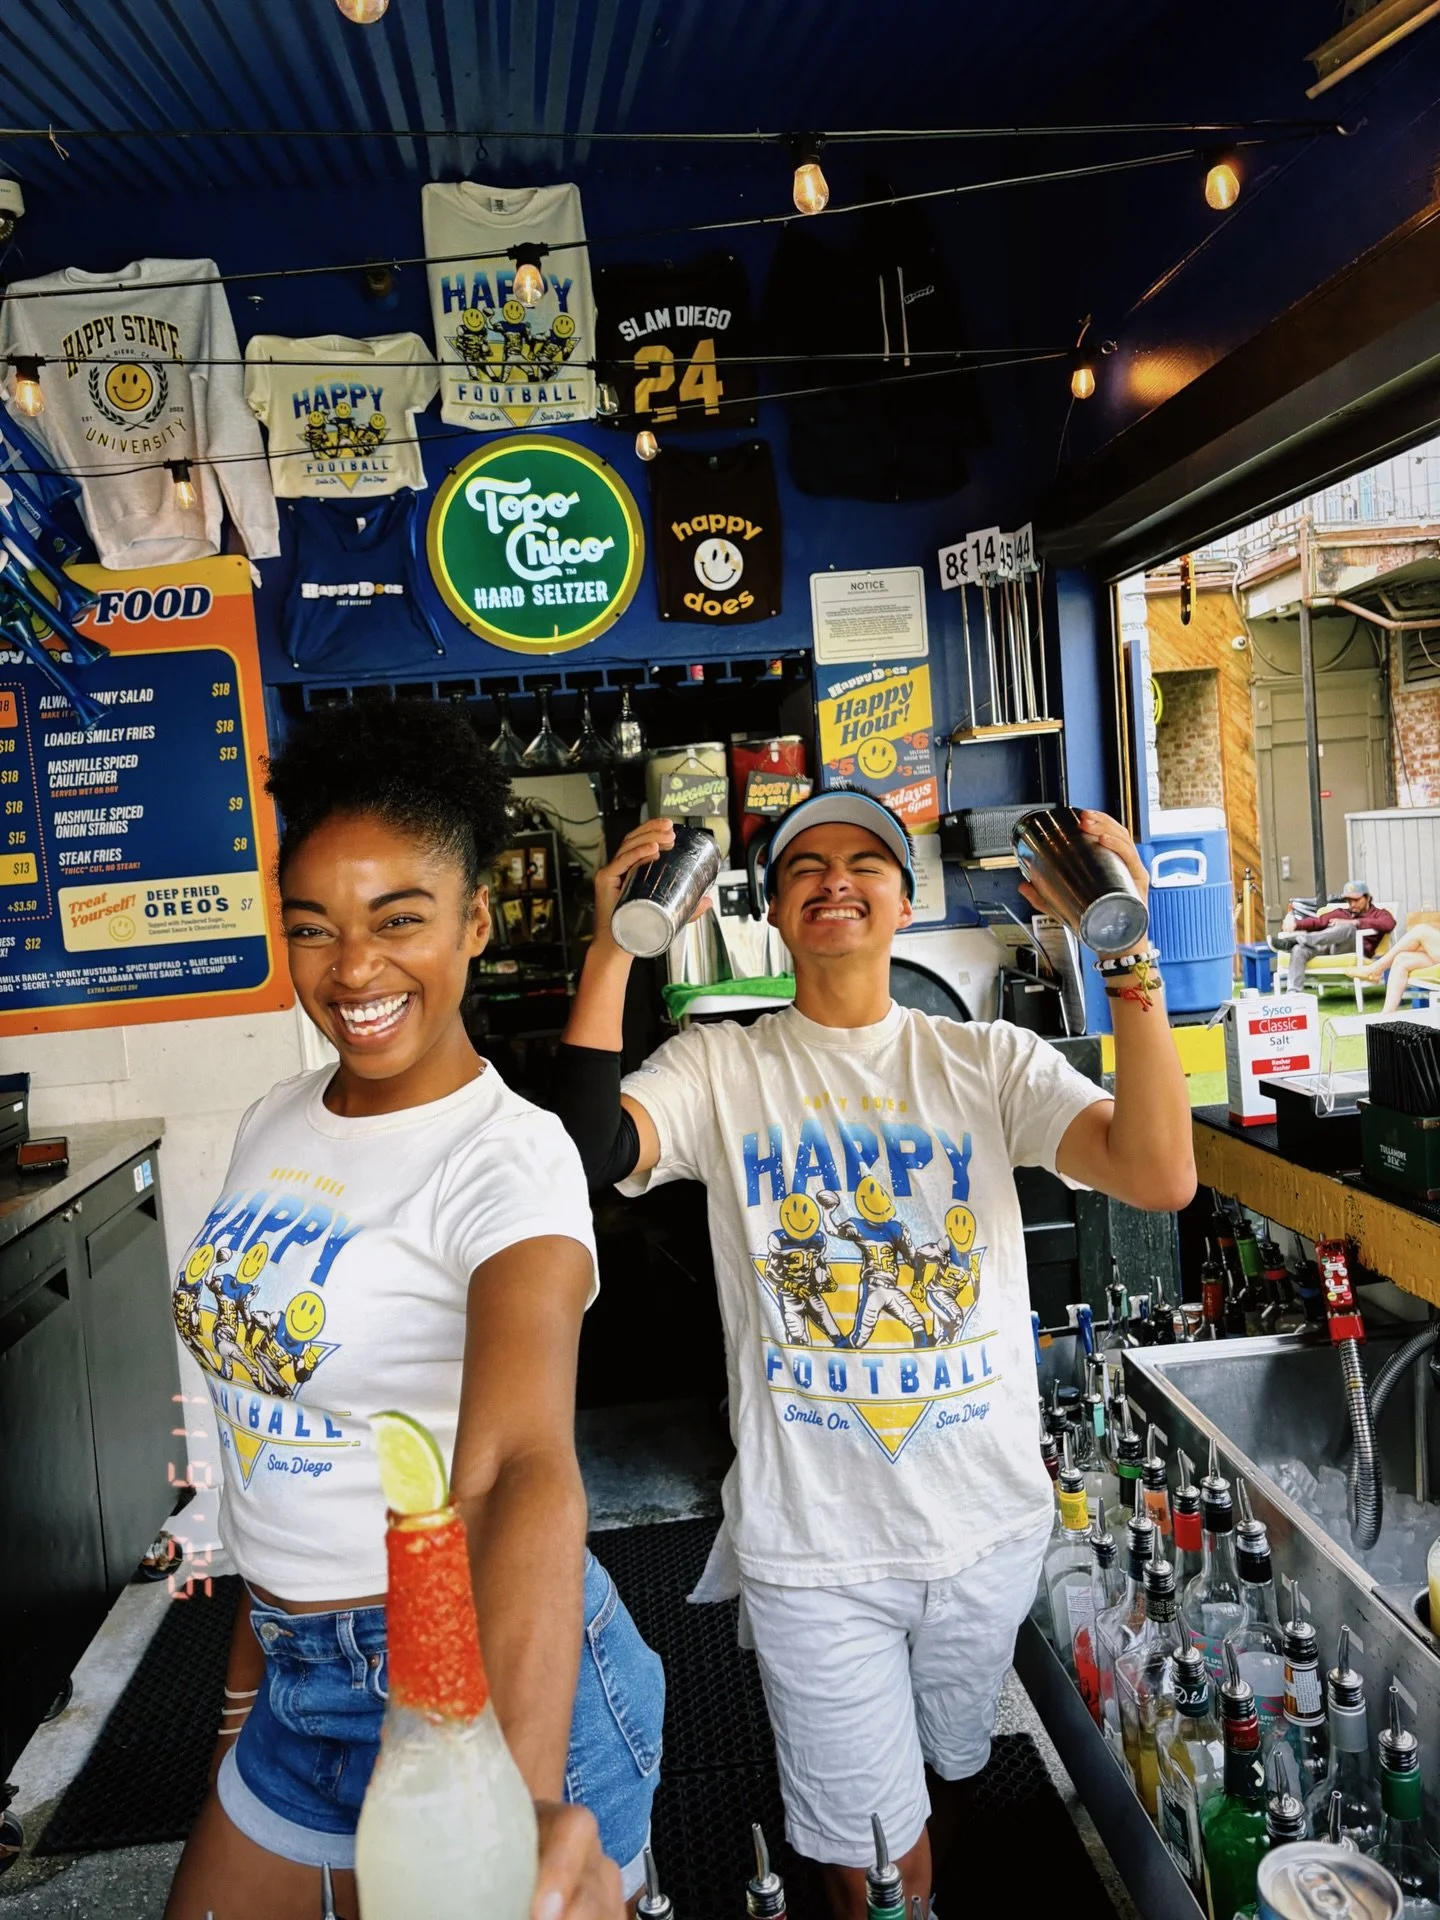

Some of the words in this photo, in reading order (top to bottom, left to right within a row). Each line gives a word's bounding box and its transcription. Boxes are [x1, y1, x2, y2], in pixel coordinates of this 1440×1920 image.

[441, 268, 573, 314] HAPY
[618, 308, 671, 342] SLAM
[675, 305, 732, 331] DIEGO
[62, 316, 116, 379] HAPPY
[121, 315, 184, 367] STATE
[458, 383, 577, 403] FOOTBALL
[634, 338, 724, 423] 24
[292, 382, 384, 420] HAPPY
[490, 412, 501, 422] On
[86, 418, 187, 455] UNIVERSITY
[306, 460, 389, 474] FOOTBALL
[465, 476, 580, 534] Topo
[671, 513, 763, 541] happy
[505, 521, 615, 582] Chico
[972, 536, 996, 567] 14
[474, 586, 525, 610] HARD
[532, 580, 609, 606] SELTZER
[850, 581, 885, 590] NOTICE
[96, 586, 212, 624] FOOD
[683, 590, 755, 616] does
[0, 700, 9, 712] 18
[120, 688, 154, 703] SALAD
[212, 683, 230, 697] $18
[833, 680, 914, 725] Happy
[44, 732, 84, 748] LOADED
[86, 728, 125, 744] SMILEY
[126, 725, 156, 741] FRIES
[216, 719, 234, 734] $18
[840, 704, 910, 746] Hour!
[48, 757, 102, 775] NASHVILLE
[103, 754, 138, 770] SPICED
[220, 746, 238, 761] $13
[1, 770, 19, 785] $18
[49, 769, 118, 789] CAULIFLOWER
[51, 789, 77, 798] SERVED
[663, 780, 726, 806] MARGARITA
[5, 800, 23, 815] $18
[54, 808, 107, 826] NASHVILLE
[109, 805, 144, 821] SPICED
[229, 797, 243, 811] $9
[8, 831, 26, 845] $15
[55, 824, 86, 839] ONION
[88, 820, 128, 836] STRINGS
[233, 837, 248, 851] $8
[13, 862, 30, 876] $13
[58, 849, 92, 867] STEAK
[93, 847, 122, 864] FRIES
[68, 892, 107, 915] Treat
[147, 888, 179, 901] DEEP
[183, 885, 220, 899] FRIED
[7, 900, 37, 913] +$3.50
[71, 894, 137, 929] Yourself!
[144, 897, 229, 919] OREOS
[240, 898, 253, 911] $7
[25, 937, 42, 950] $12
[22, 972, 47, 982] RANCH
[56, 968, 81, 979] HONEY
[82, 965, 117, 977] MUSTARD
[125, 963, 147, 973] SPICY
[149, 960, 181, 971] BUFFALO
[189, 957, 208, 967] BLUE
[209, 955, 237, 965] CHEESE
[22, 980, 50, 991] SECRET
[66, 976, 90, 987] SAUCE
[98, 972, 134, 984] ALABAMA
[135, 969, 158, 980] WHITE
[160, 967, 183, 979] SAUCE
[192, 965, 225, 975] KETCHUP
[1262, 1005, 1292, 1017] Sysco
[1258, 1019, 1298, 1033] Classic
[1270, 1036, 1290, 1046] Salt
[742, 1119, 973, 1207] HAPPY
[1379, 1144, 1407, 1161] TULLAMORE
[197, 1188, 366, 1288] HAPPY
[868, 1245, 894, 1273] 12
[767, 1345, 992, 1394] FOOTBALL
[209, 1379, 342, 1439] OOTBALL
[784, 1404, 823, 1426] Smile
[827, 1412, 850, 1430] On
[936, 1411, 960, 1429] San
[267, 1453, 289, 1471] San
[291, 1456, 333, 1478] Diego
